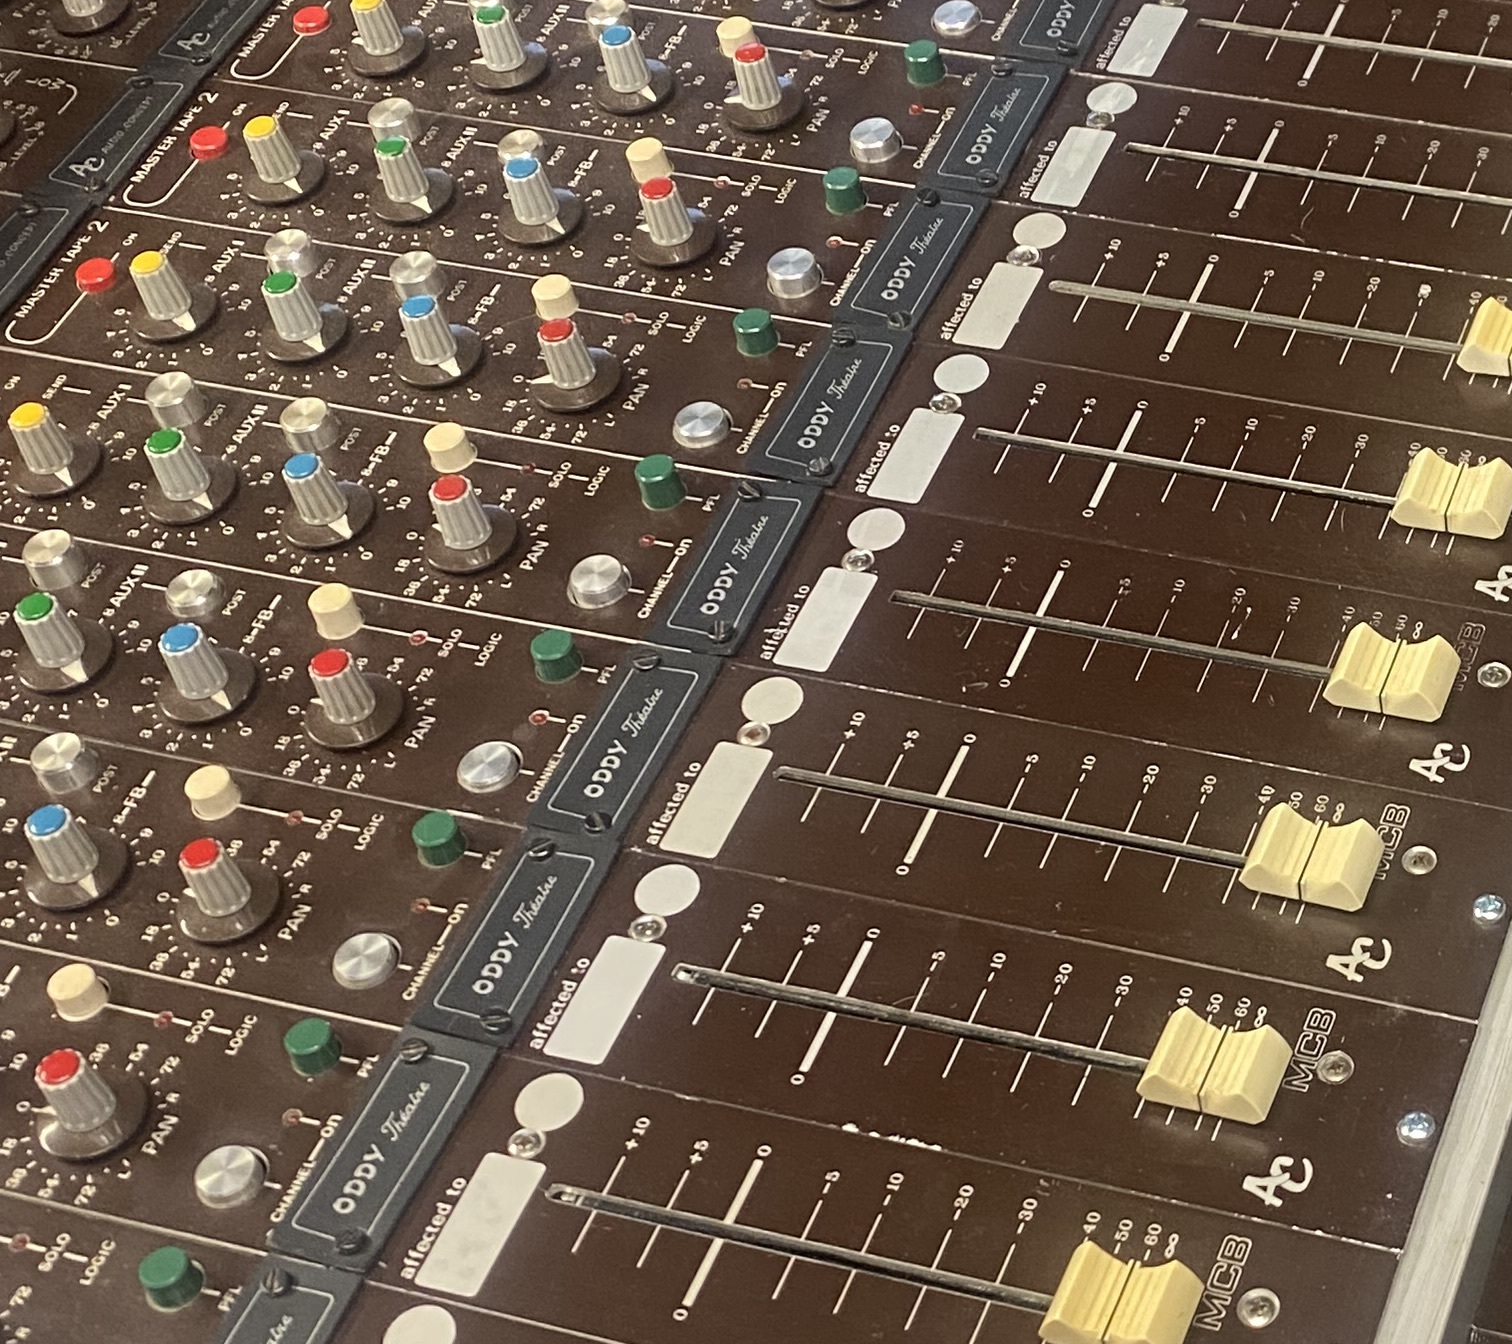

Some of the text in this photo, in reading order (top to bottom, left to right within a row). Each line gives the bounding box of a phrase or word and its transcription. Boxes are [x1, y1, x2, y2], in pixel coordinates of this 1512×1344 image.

[238, 7, 282, 59] MASTER
[132, 91, 220, 184] MASTER TAPE 2
[966, 124, 997, 165] ODDY
[1019, 140, 1057, 198] affected to
[15, 219, 110, 319] MASTER TAPE 2
[212, 250, 236, 274] AUX
[342, 271, 366, 296] AUX
[881, 256, 916, 301] ODDY
[940, 277, 983, 340] affected to
[96, 391, 125, 421] AUX
[797, 401, 834, 450] ODDY
[736, 411, 770, 455] CHANNEL
[855, 424, 901, 494] affected to
[519, 539, 550, 571] PAN
[110, 578, 137, 609] AUX
[222, 589, 246, 616] POST
[637, 572, 674, 620] CHANNEL
[700, 563, 739, 616] ODDY
[795, 585, 811, 602] to
[437, 628, 463, 658] SOLO
[474, 632, 502, 667] LOGIC
[597, 663, 617, 687] PFL
[404, 714, 436, 749] PAN
[525, 751, 565, 804] CHANNEL
[584, 740, 628, 799] ODDY
[315, 808, 343, 841] SOLO
[647, 762, 702, 846] affected to
[354, 813, 385, 851] LOGIC
[277, 903, 313, 941] PAN
[402, 943, 446, 1002] CHANNEL
[472, 931, 520, 996] ODDY
[530, 957, 591, 1050] affected to
[184, 1008, 216, 1045] SOLO
[224, 1014, 259, 1056] LOGIC
[357, 1053, 380, 1080] PFL
[141, 1113, 180, 1156] PAN
[757, 1144, 773, 1157] 0
[269, 1158, 317, 1224] CHANNEL
[333, 1145, 385, 1214] ODDY
[401, 1176, 468, 1280] affected to
[79, 1239, 117, 1286] LOGIC
[672, 1308, 689, 1321] 0
